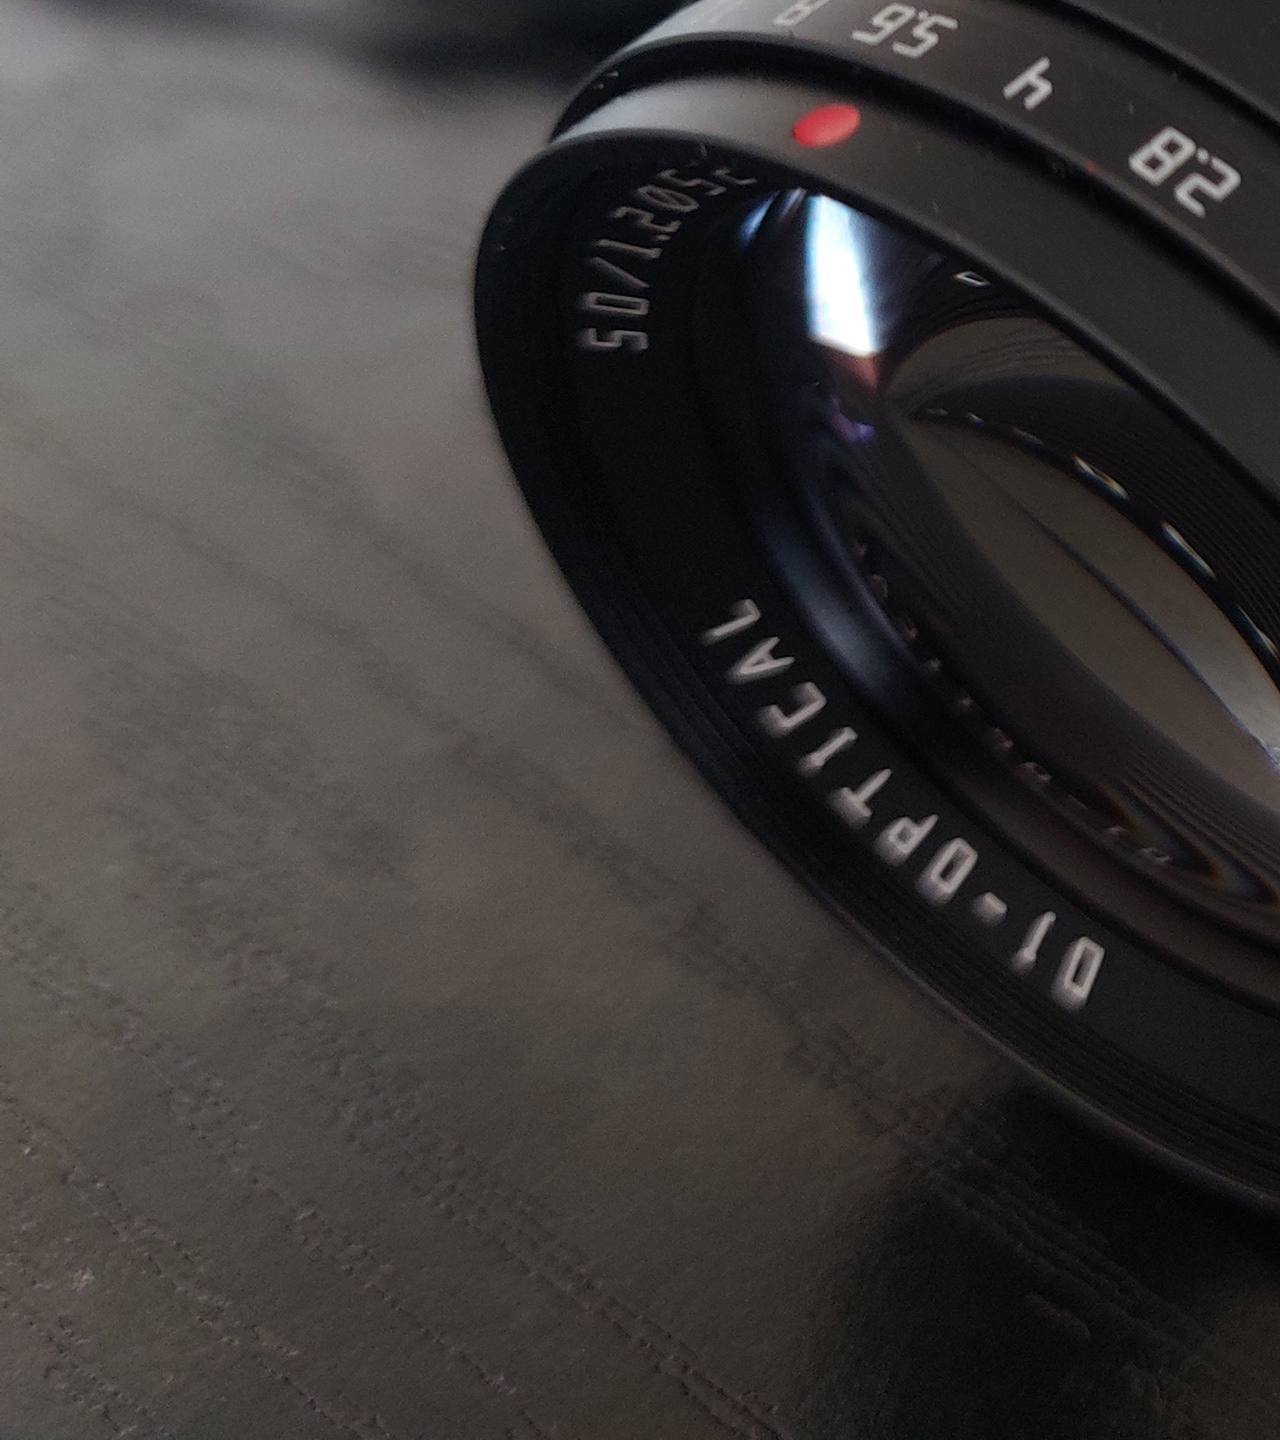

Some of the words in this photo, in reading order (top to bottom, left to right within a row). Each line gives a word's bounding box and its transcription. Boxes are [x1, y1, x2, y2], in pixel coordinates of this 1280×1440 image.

[851, 2, 958, 58] 5.6
[1003, 57, 1052, 109] 4
[1129, 126, 1241, 216] 2.8
